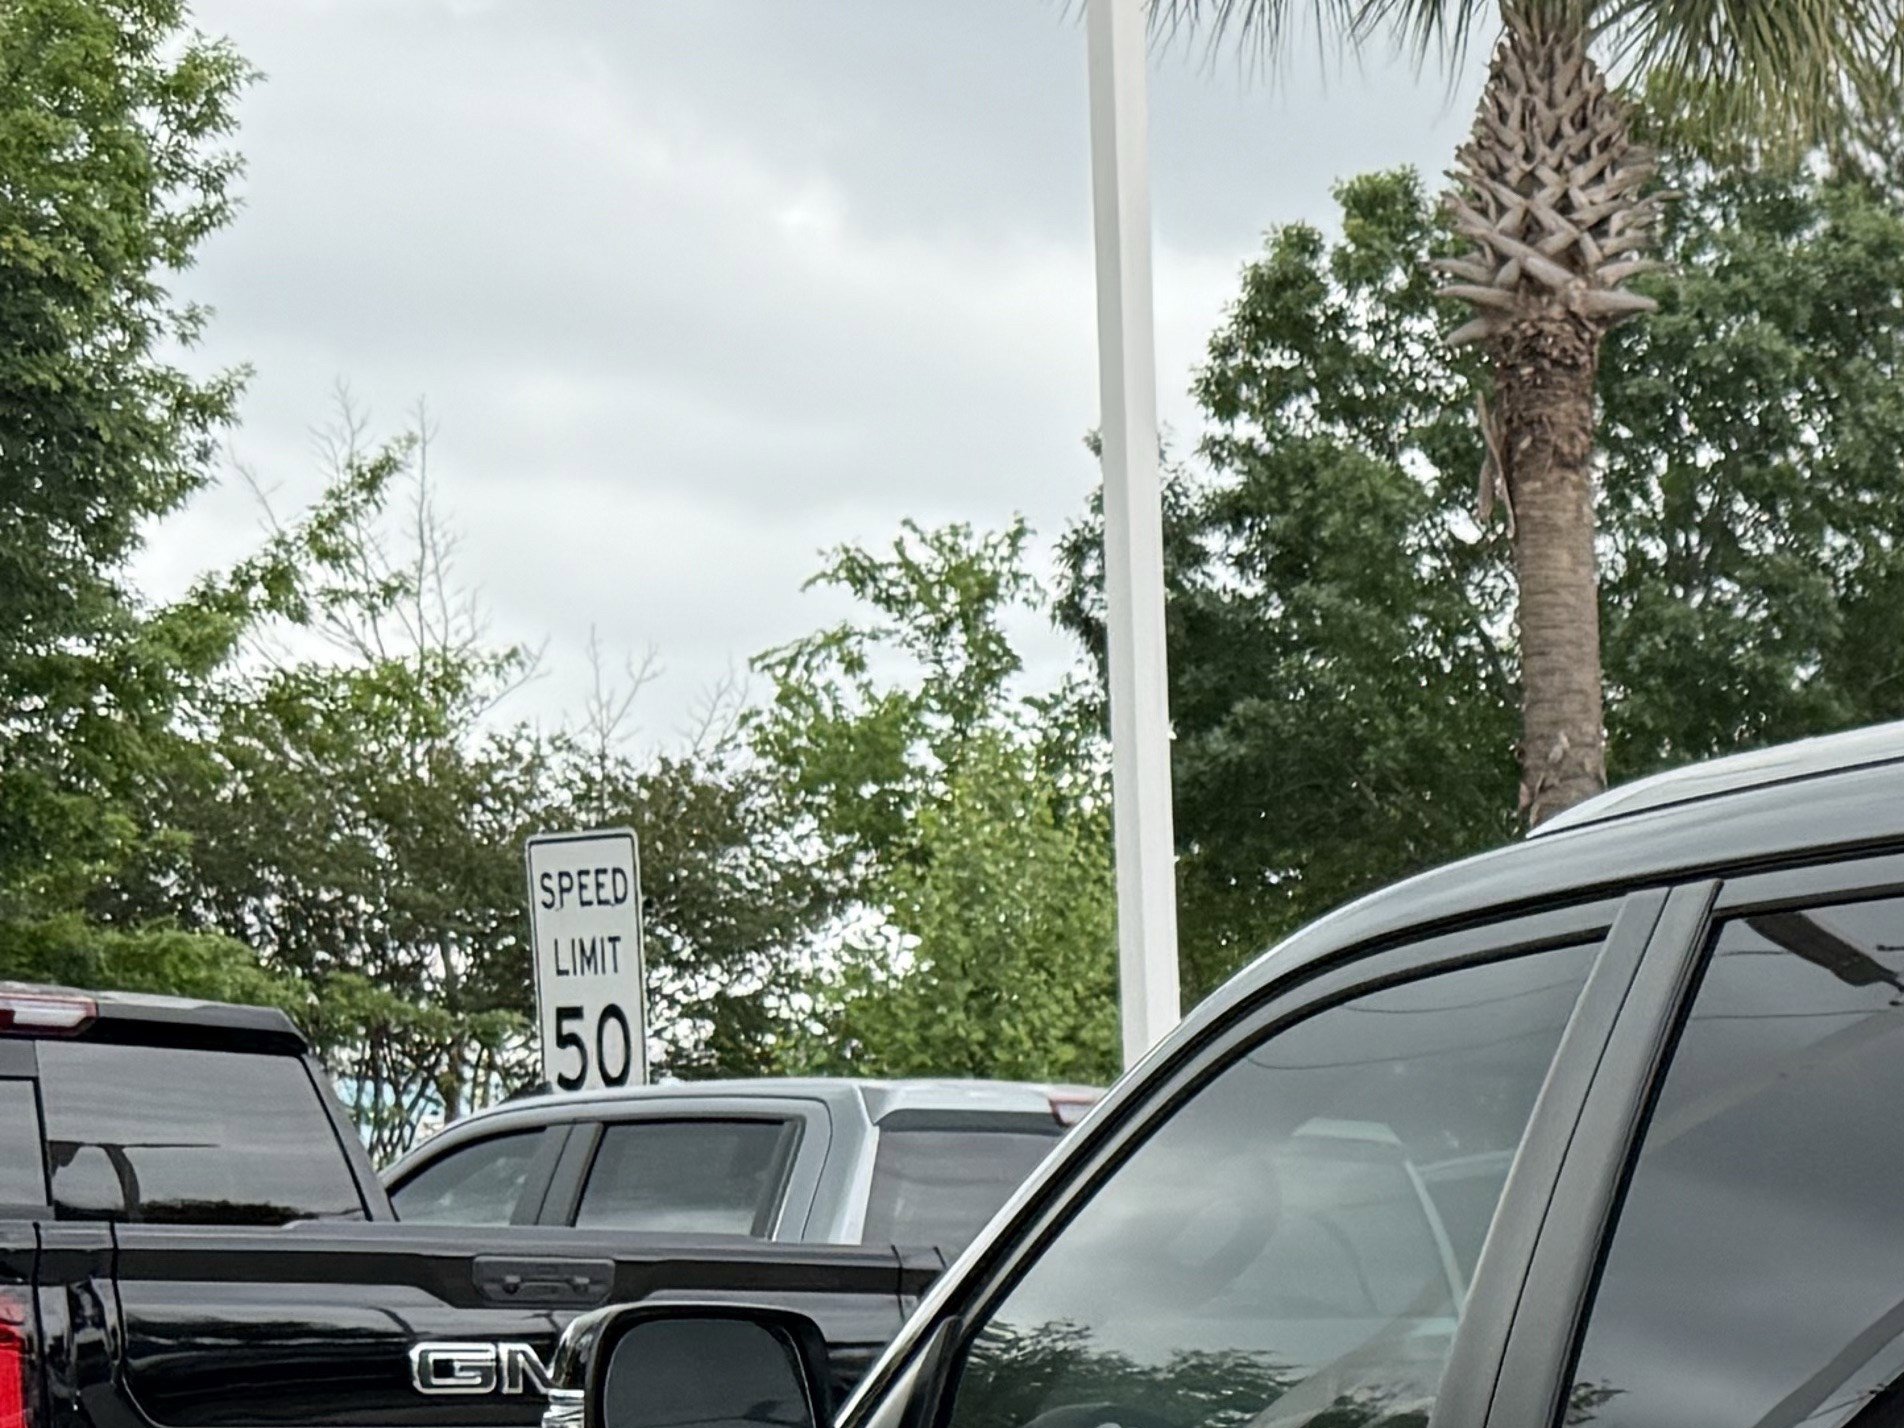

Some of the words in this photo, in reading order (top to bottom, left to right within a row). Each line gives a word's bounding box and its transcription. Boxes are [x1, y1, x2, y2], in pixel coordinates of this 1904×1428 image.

[540, 866, 628, 910] SPEED
[554, 935, 621, 977] LIMIT
[555, 1003, 632, 1092] 50
[408, 1341, 556, 1395] GM
